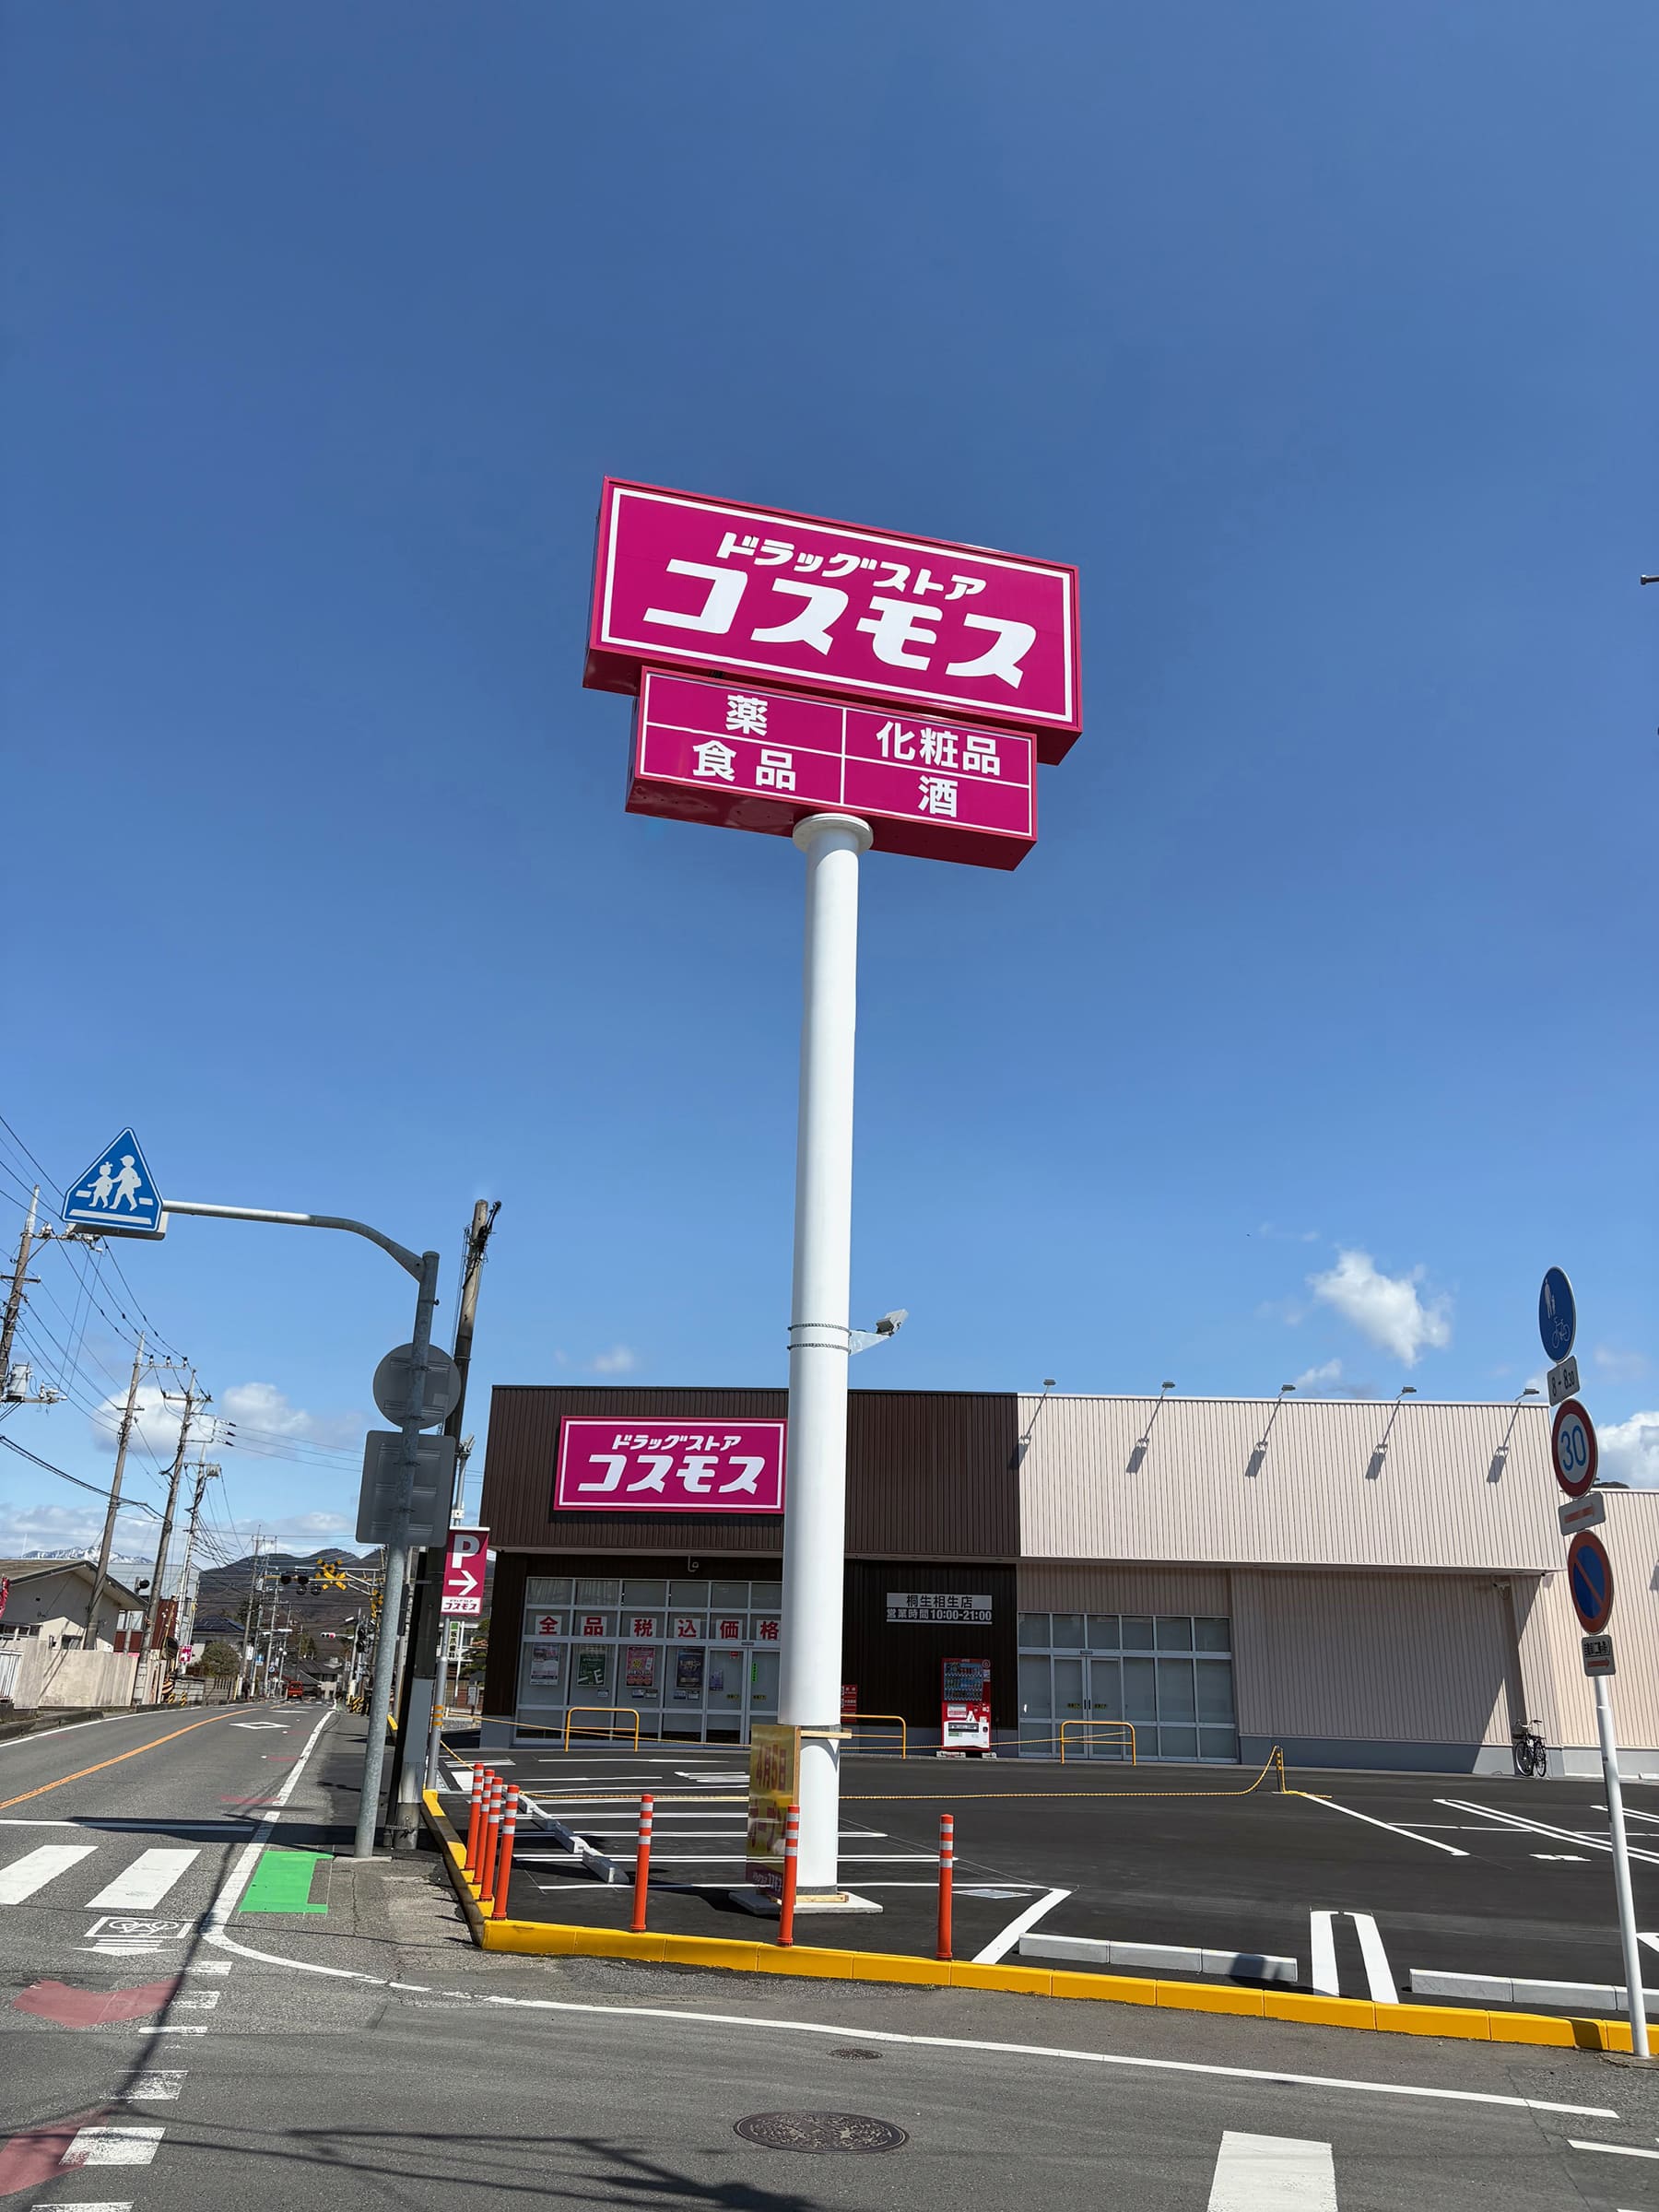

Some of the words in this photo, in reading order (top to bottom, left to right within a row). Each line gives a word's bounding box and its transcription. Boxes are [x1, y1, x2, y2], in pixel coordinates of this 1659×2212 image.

[716, 531, 986, 600] ドラッグストア
[642, 559, 1037, 689] コスモス
[725, 694, 768, 736] 薬
[692, 740, 796, 791] 食品
[876, 721, 1001, 775] 化粧品
[918, 775, 958, 818] 酒
[612, 1434, 742, 1452] ドラッグストア
[1560, 1425, 1586, 1471] 30
[577, 1454, 765, 1495] コスモス
[452, 1534, 480, 1569] P
[906, 1594, 973, 1608] 桐生相生店
